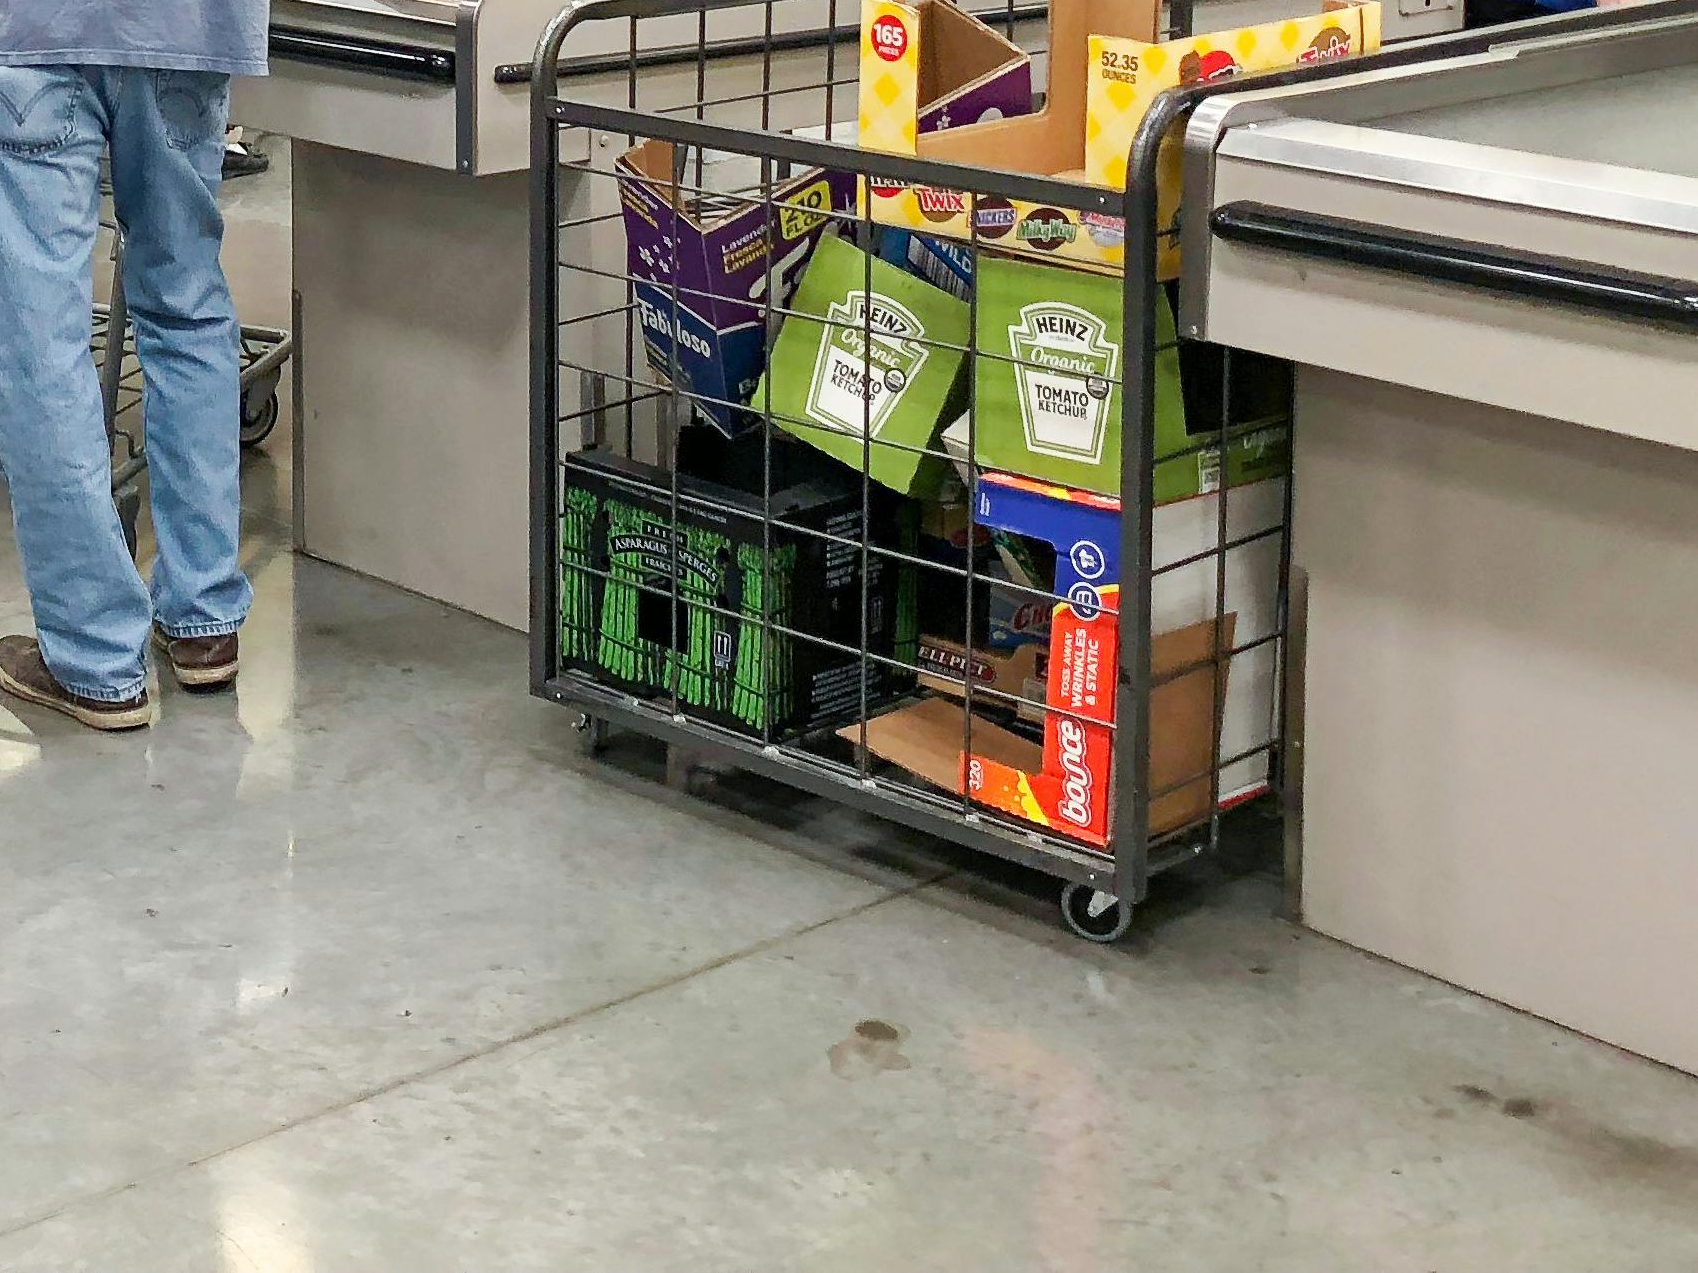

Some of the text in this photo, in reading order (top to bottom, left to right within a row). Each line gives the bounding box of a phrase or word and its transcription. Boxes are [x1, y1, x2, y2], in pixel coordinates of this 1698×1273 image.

[873, 24, 904, 46] 165
[878, 45, 900, 55] PIECES
[1101, 50, 1140, 73] 52.35
[1101, 69, 1137, 85] OUNCES
[1036, 316, 1090, 342] HEINZ
[1030, 347, 1095, 376] Organic
[1035, 384, 1090, 408] TOMATO
[1038, 401, 1088, 419] KETCHUP
[614, 537, 668, 555] ASPARAGUS
[1060, 631, 1073, 699] TOSS AWAY
[1071, 627, 1088, 709] WRINKLES
[1085, 640, 1100, 706] & STATIC
[969, 759, 983, 791] 320
[1058, 717, 1092, 828] bounce
